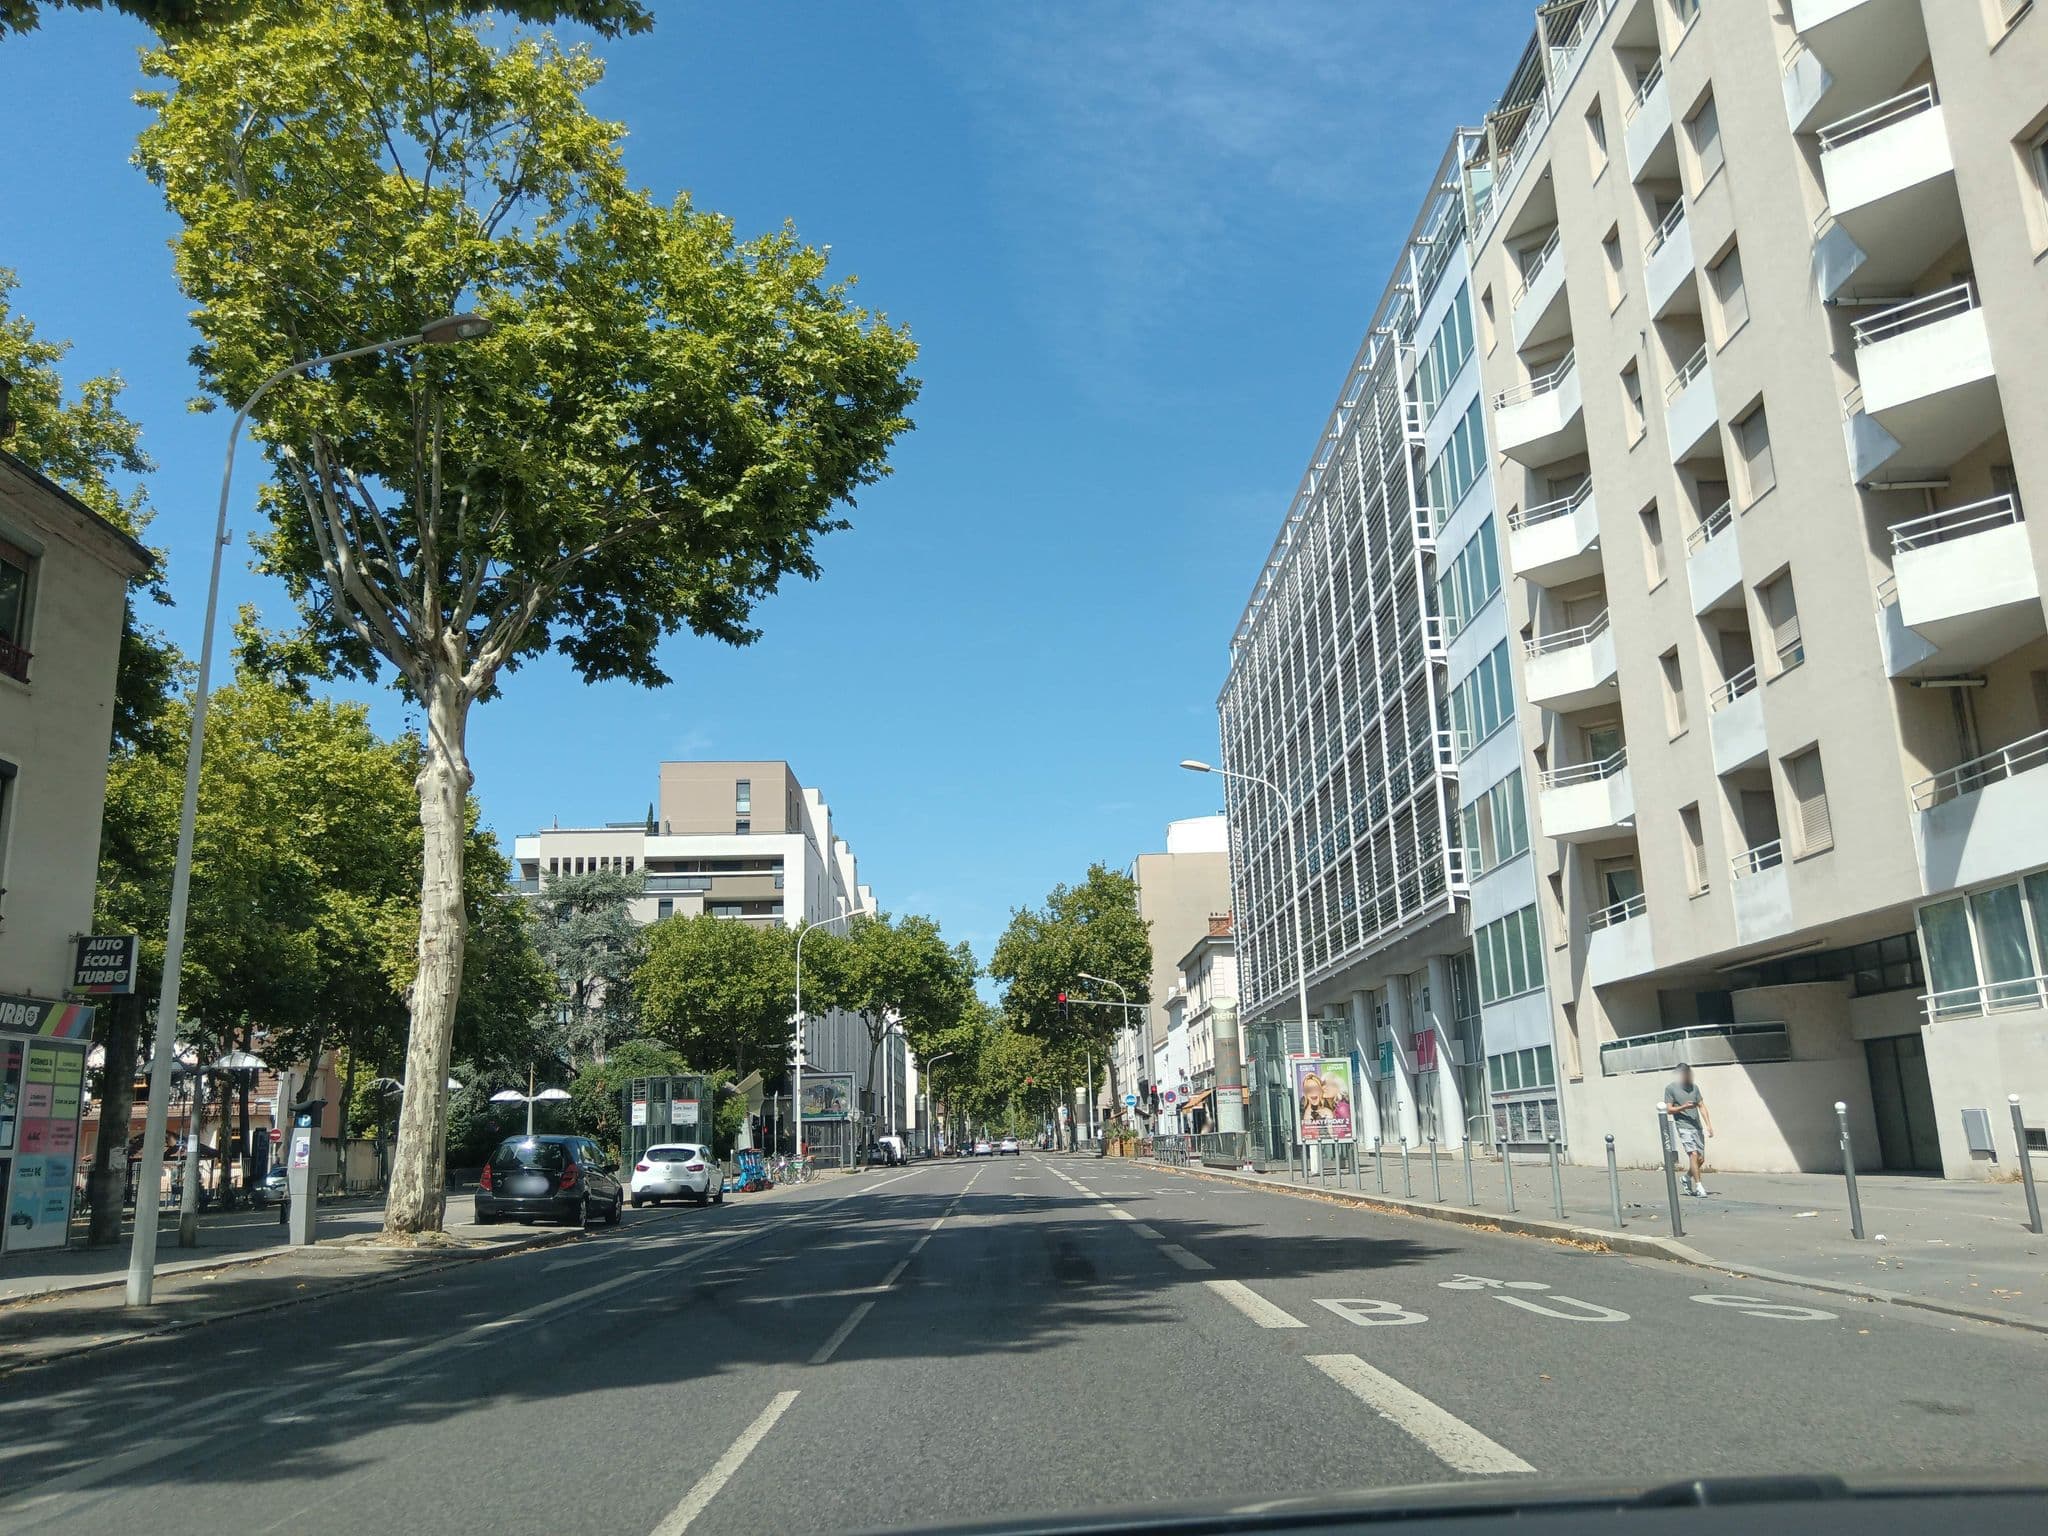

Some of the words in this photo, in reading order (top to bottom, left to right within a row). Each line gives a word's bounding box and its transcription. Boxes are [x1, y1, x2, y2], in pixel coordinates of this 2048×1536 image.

[87, 939, 124, 950] AUTO
[82, 952, 125, 967] ÉCOLE
[77, 970, 128, 984] TURBO
[1312, 1294, 1838, 1327] BUS
